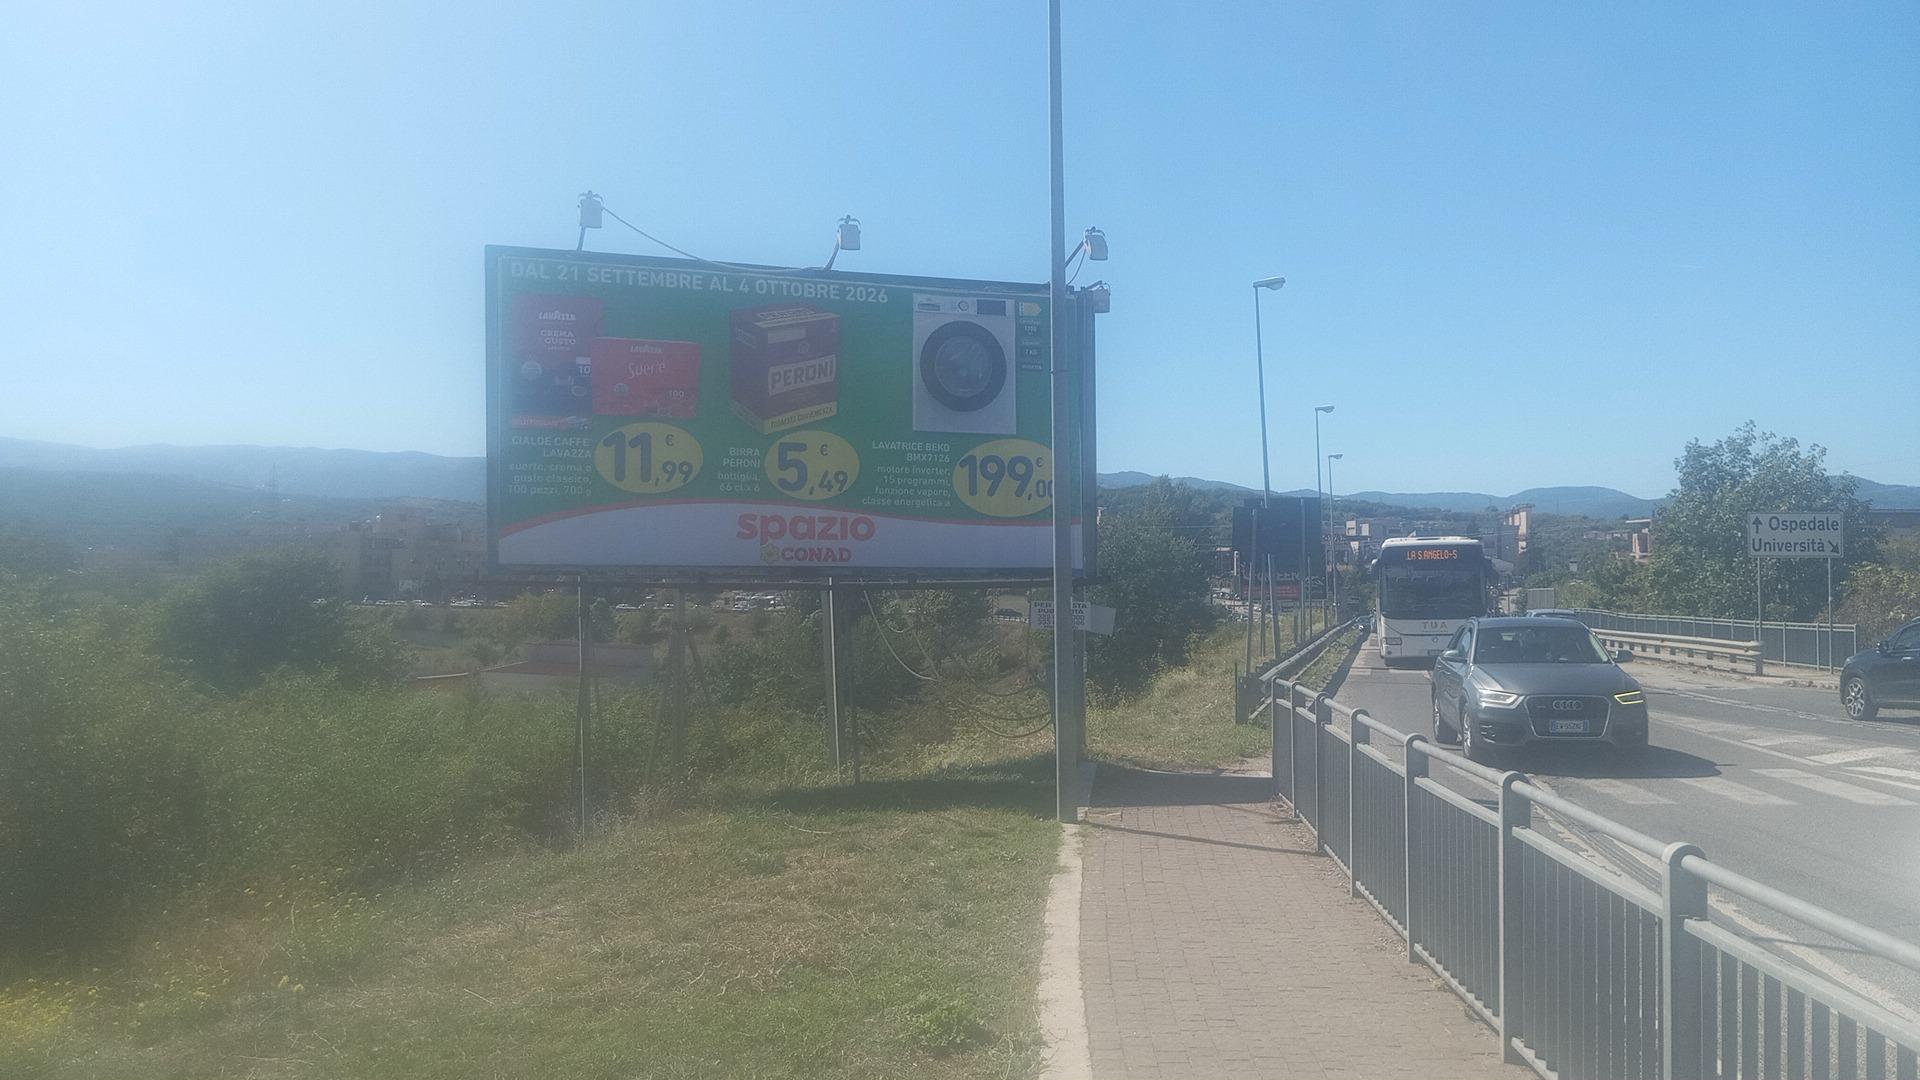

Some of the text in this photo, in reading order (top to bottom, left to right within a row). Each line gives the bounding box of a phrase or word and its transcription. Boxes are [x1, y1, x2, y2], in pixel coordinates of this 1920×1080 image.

[511, 262, 888, 304] DAL 21 SETTEMBRE AL 4 OTTOBRE 2026
[771, 360, 834, 389] PERONI
[511, 435, 551, 447] CIALDE
[665, 434, 675, 447] €
[872, 439, 950, 452] LAVATRICE BEKO
[543, 448, 592, 459] LAVAZZA
[729, 447, 761, 457] BIRRA
[722, 458, 761, 468] PERONI
[1035, 457, 1044, 468] €
[778, 442, 848, 495] 5,49 €
[877, 465, 910, 474] motore
[512, 475, 542, 484] gusto
[884, 475, 895, 484] 15
[875, 487, 914, 496] funzione
[862, 497, 892, 506] classe
[894, 498, 942, 508] energetica
[736, 513, 876, 545] spazio
[1769, 516, 1839, 533] Ospedale
[1752, 538, 1825, 552] Università
[781, 547, 852, 562] CONAD
[1423, 621, 1448, 629] TUA
